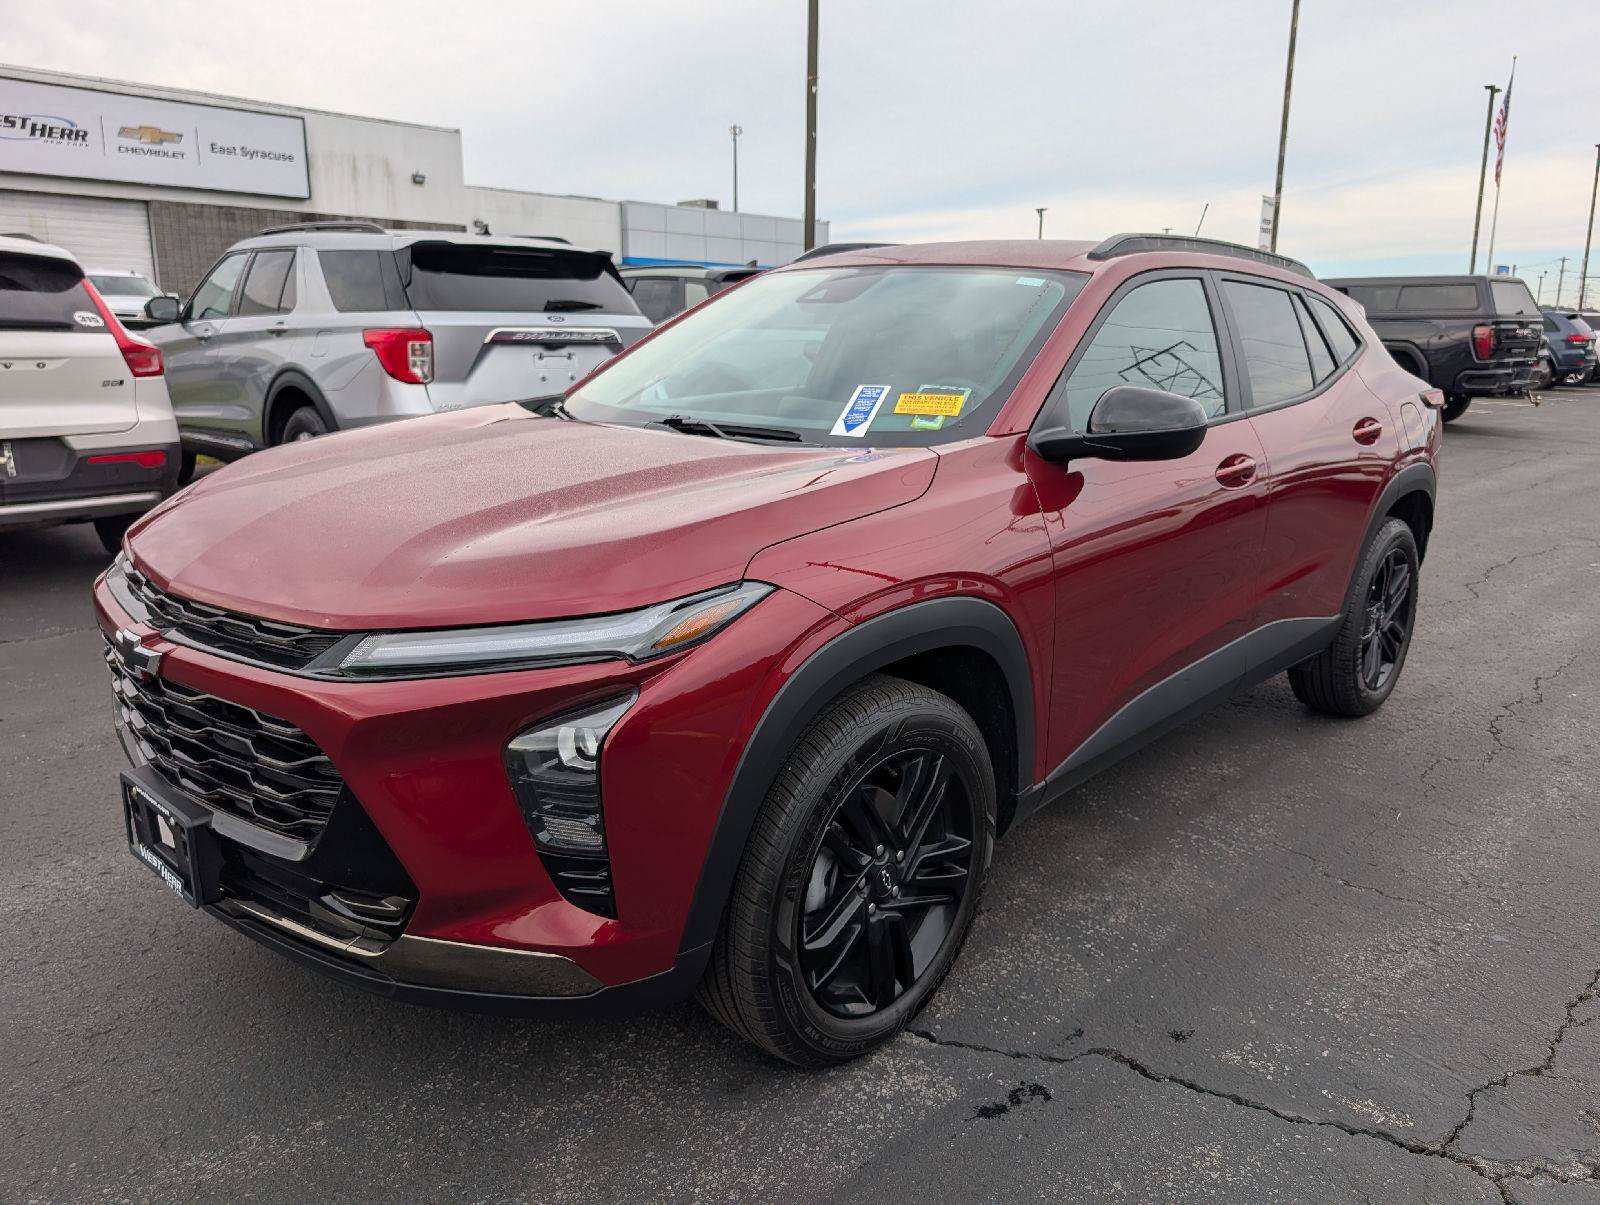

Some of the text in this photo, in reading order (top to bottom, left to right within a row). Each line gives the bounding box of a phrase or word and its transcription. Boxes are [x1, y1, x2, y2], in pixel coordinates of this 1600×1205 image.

[30, 122, 89, 142] HERR
[118, 145, 185, 160] CHEVROLET
[210, 143, 295, 162] East Syracuse
[139, 844, 162, 870] WEST
[161, 867, 182, 892] HERR
